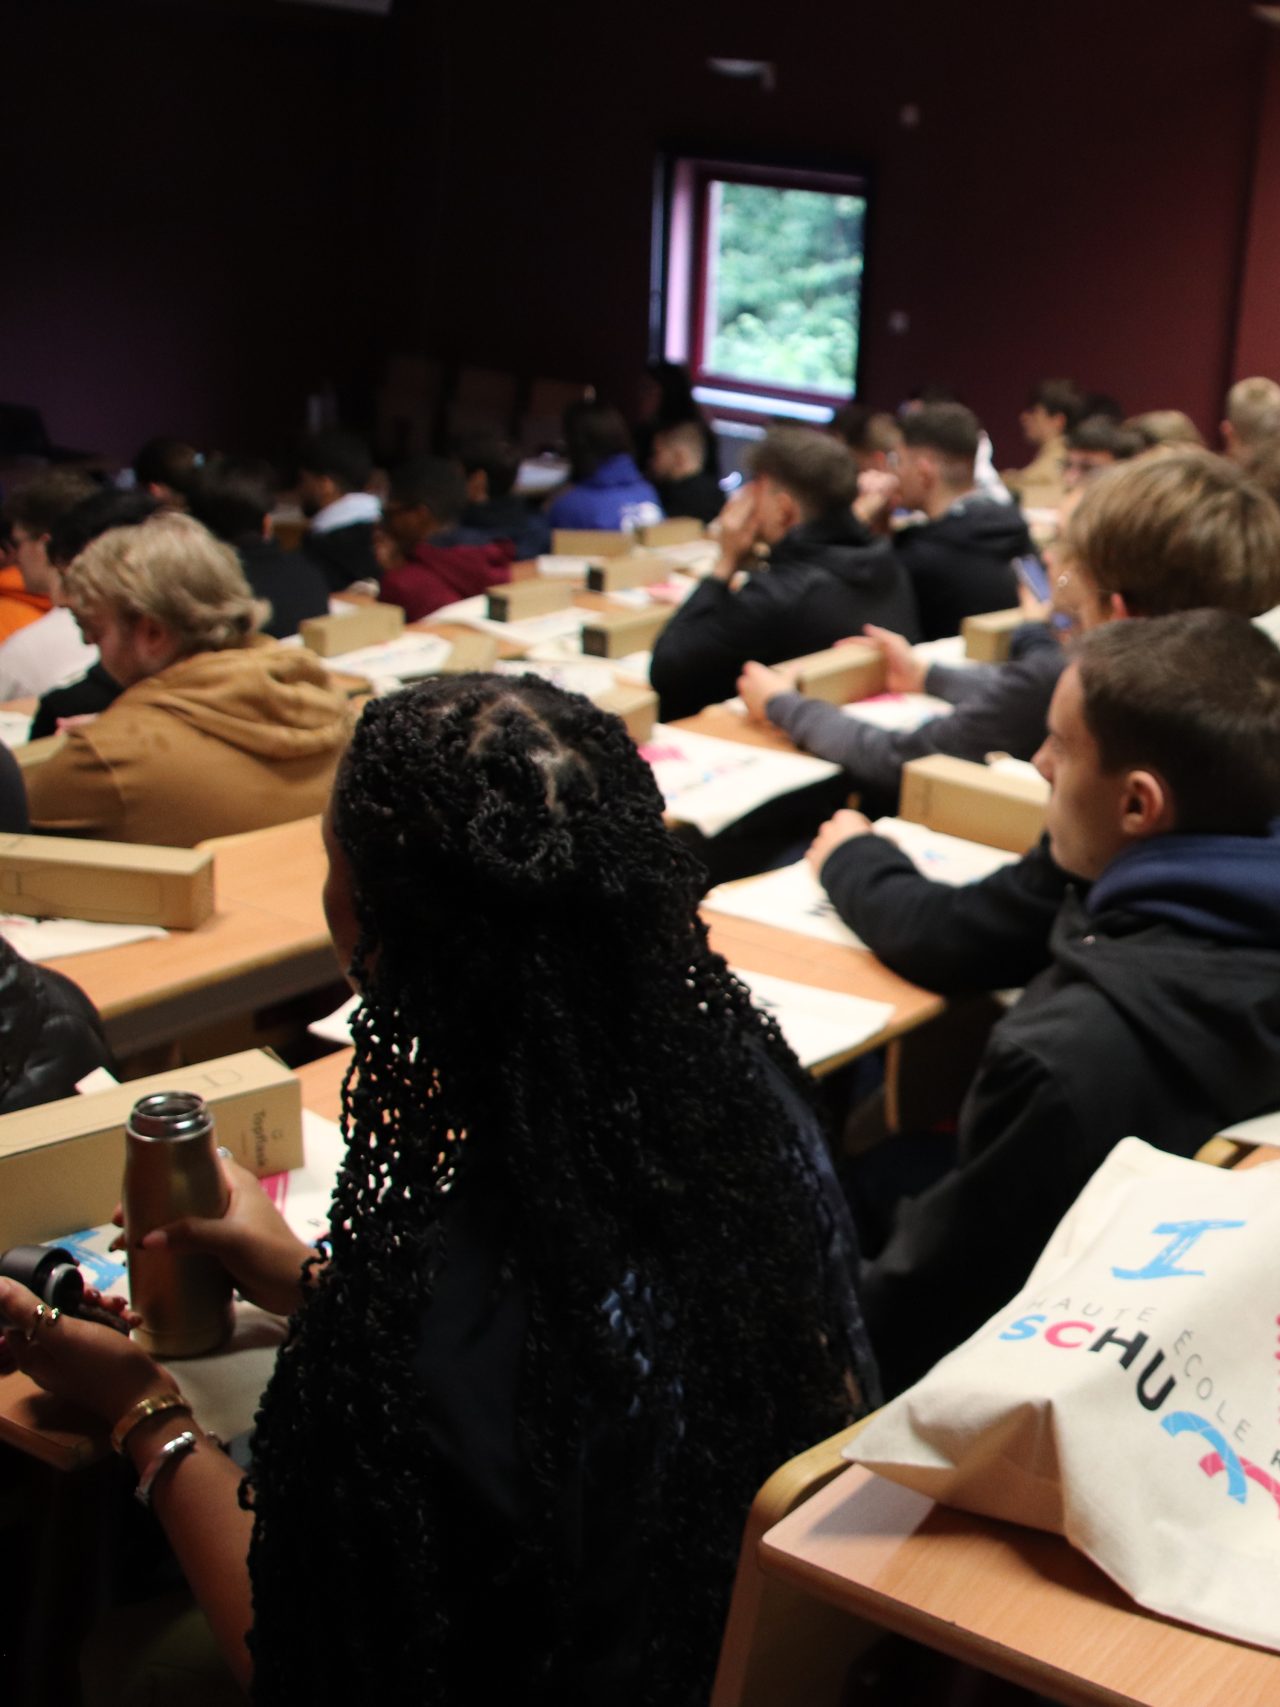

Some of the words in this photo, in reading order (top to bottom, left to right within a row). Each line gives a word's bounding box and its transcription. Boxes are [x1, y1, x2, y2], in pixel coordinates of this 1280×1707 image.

[1110, 1219, 1247, 1280] I
[1028, 1298, 1157, 1323] HAUTE
[1173, 1329, 1251, 1442] ÉCOLE
